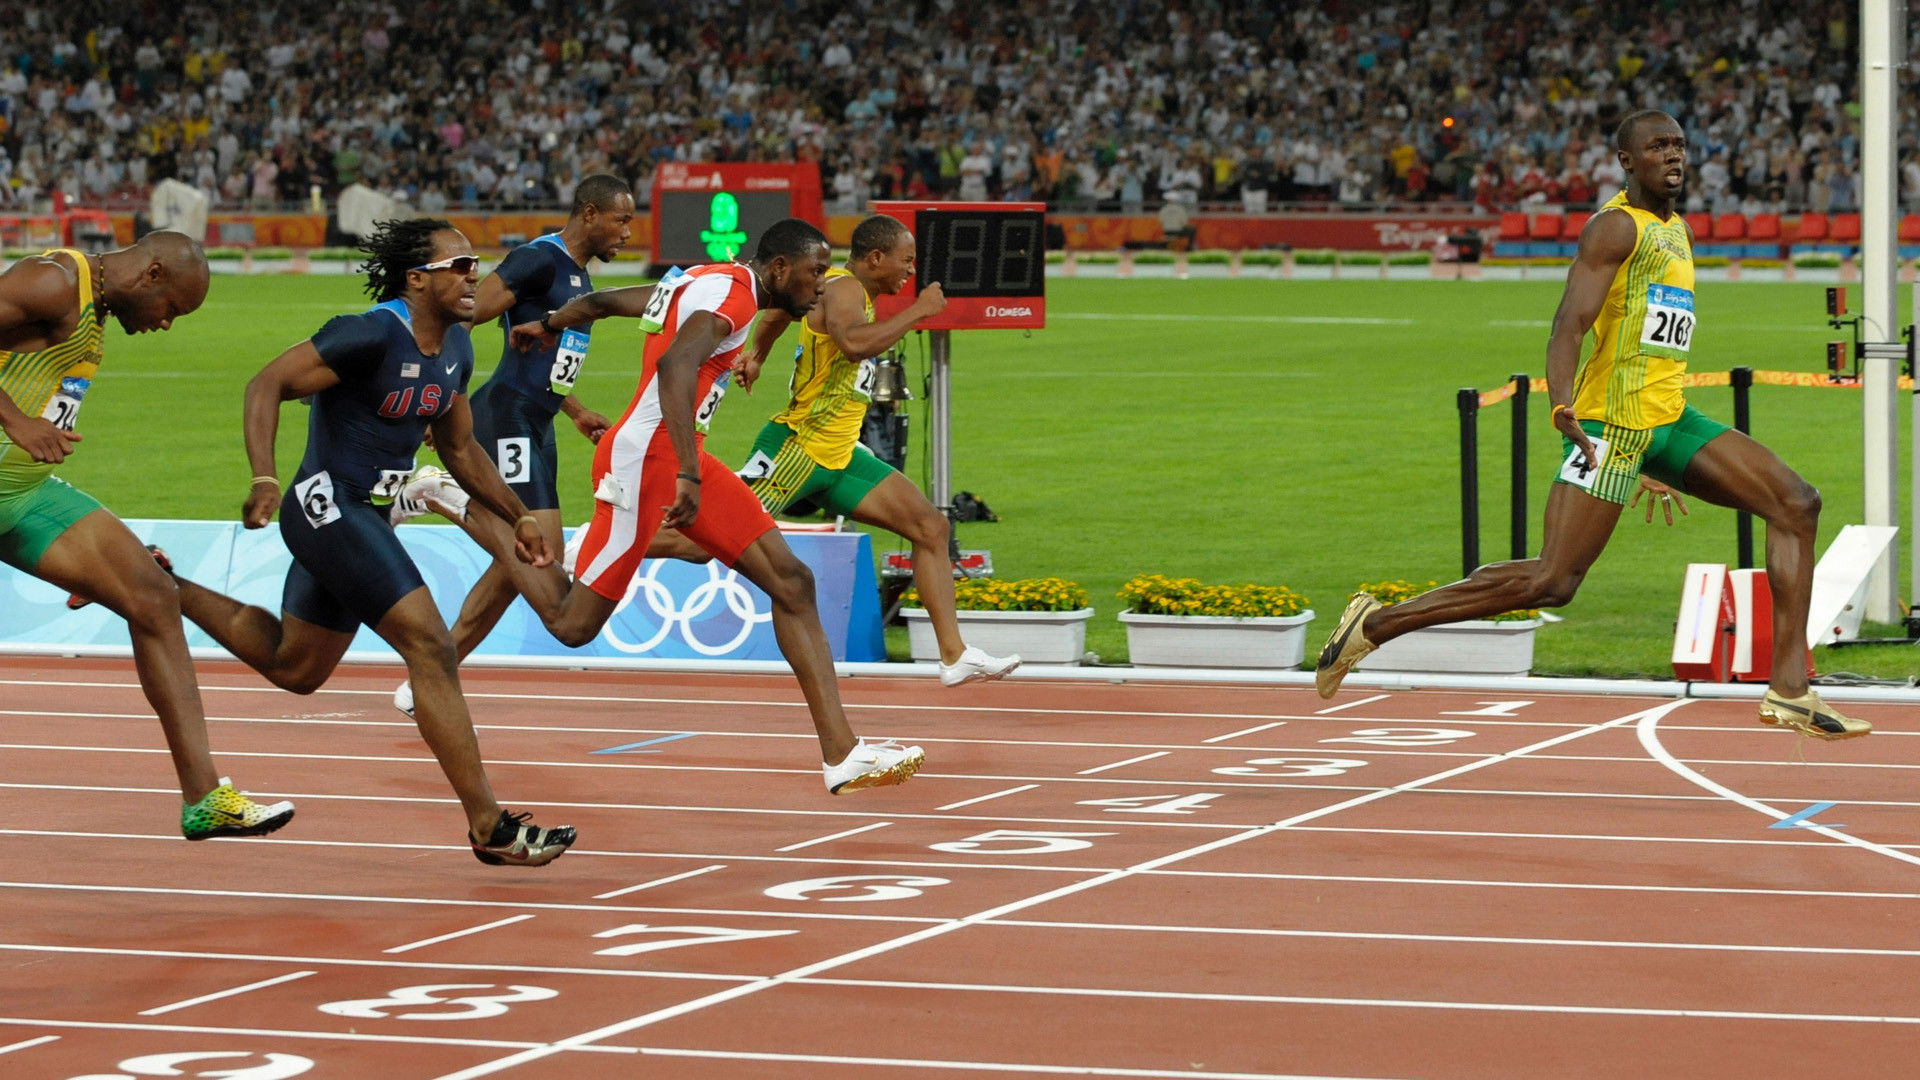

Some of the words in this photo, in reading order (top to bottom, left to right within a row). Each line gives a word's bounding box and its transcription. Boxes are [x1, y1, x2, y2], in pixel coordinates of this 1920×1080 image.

[709, 172, 723, 188] A
[1650, 311, 1692, 347] 2163
[556, 355, 583, 384] 32
[505, 443, 522, 478] 3
[1570, 442, 1598, 480] 4
[304, 478, 328, 523] 6
[1438, 700, 1536, 717] 1
[1317, 727, 1477, 747] 2
[1210, 757, 1369, 777] 3
[1075, 792, 1225, 815] 4
[927, 829, 1119, 855] 5
[762, 874, 951, 902] 6
[592, 924, 800, 956] 7
[317, 984, 559, 1021] 8
